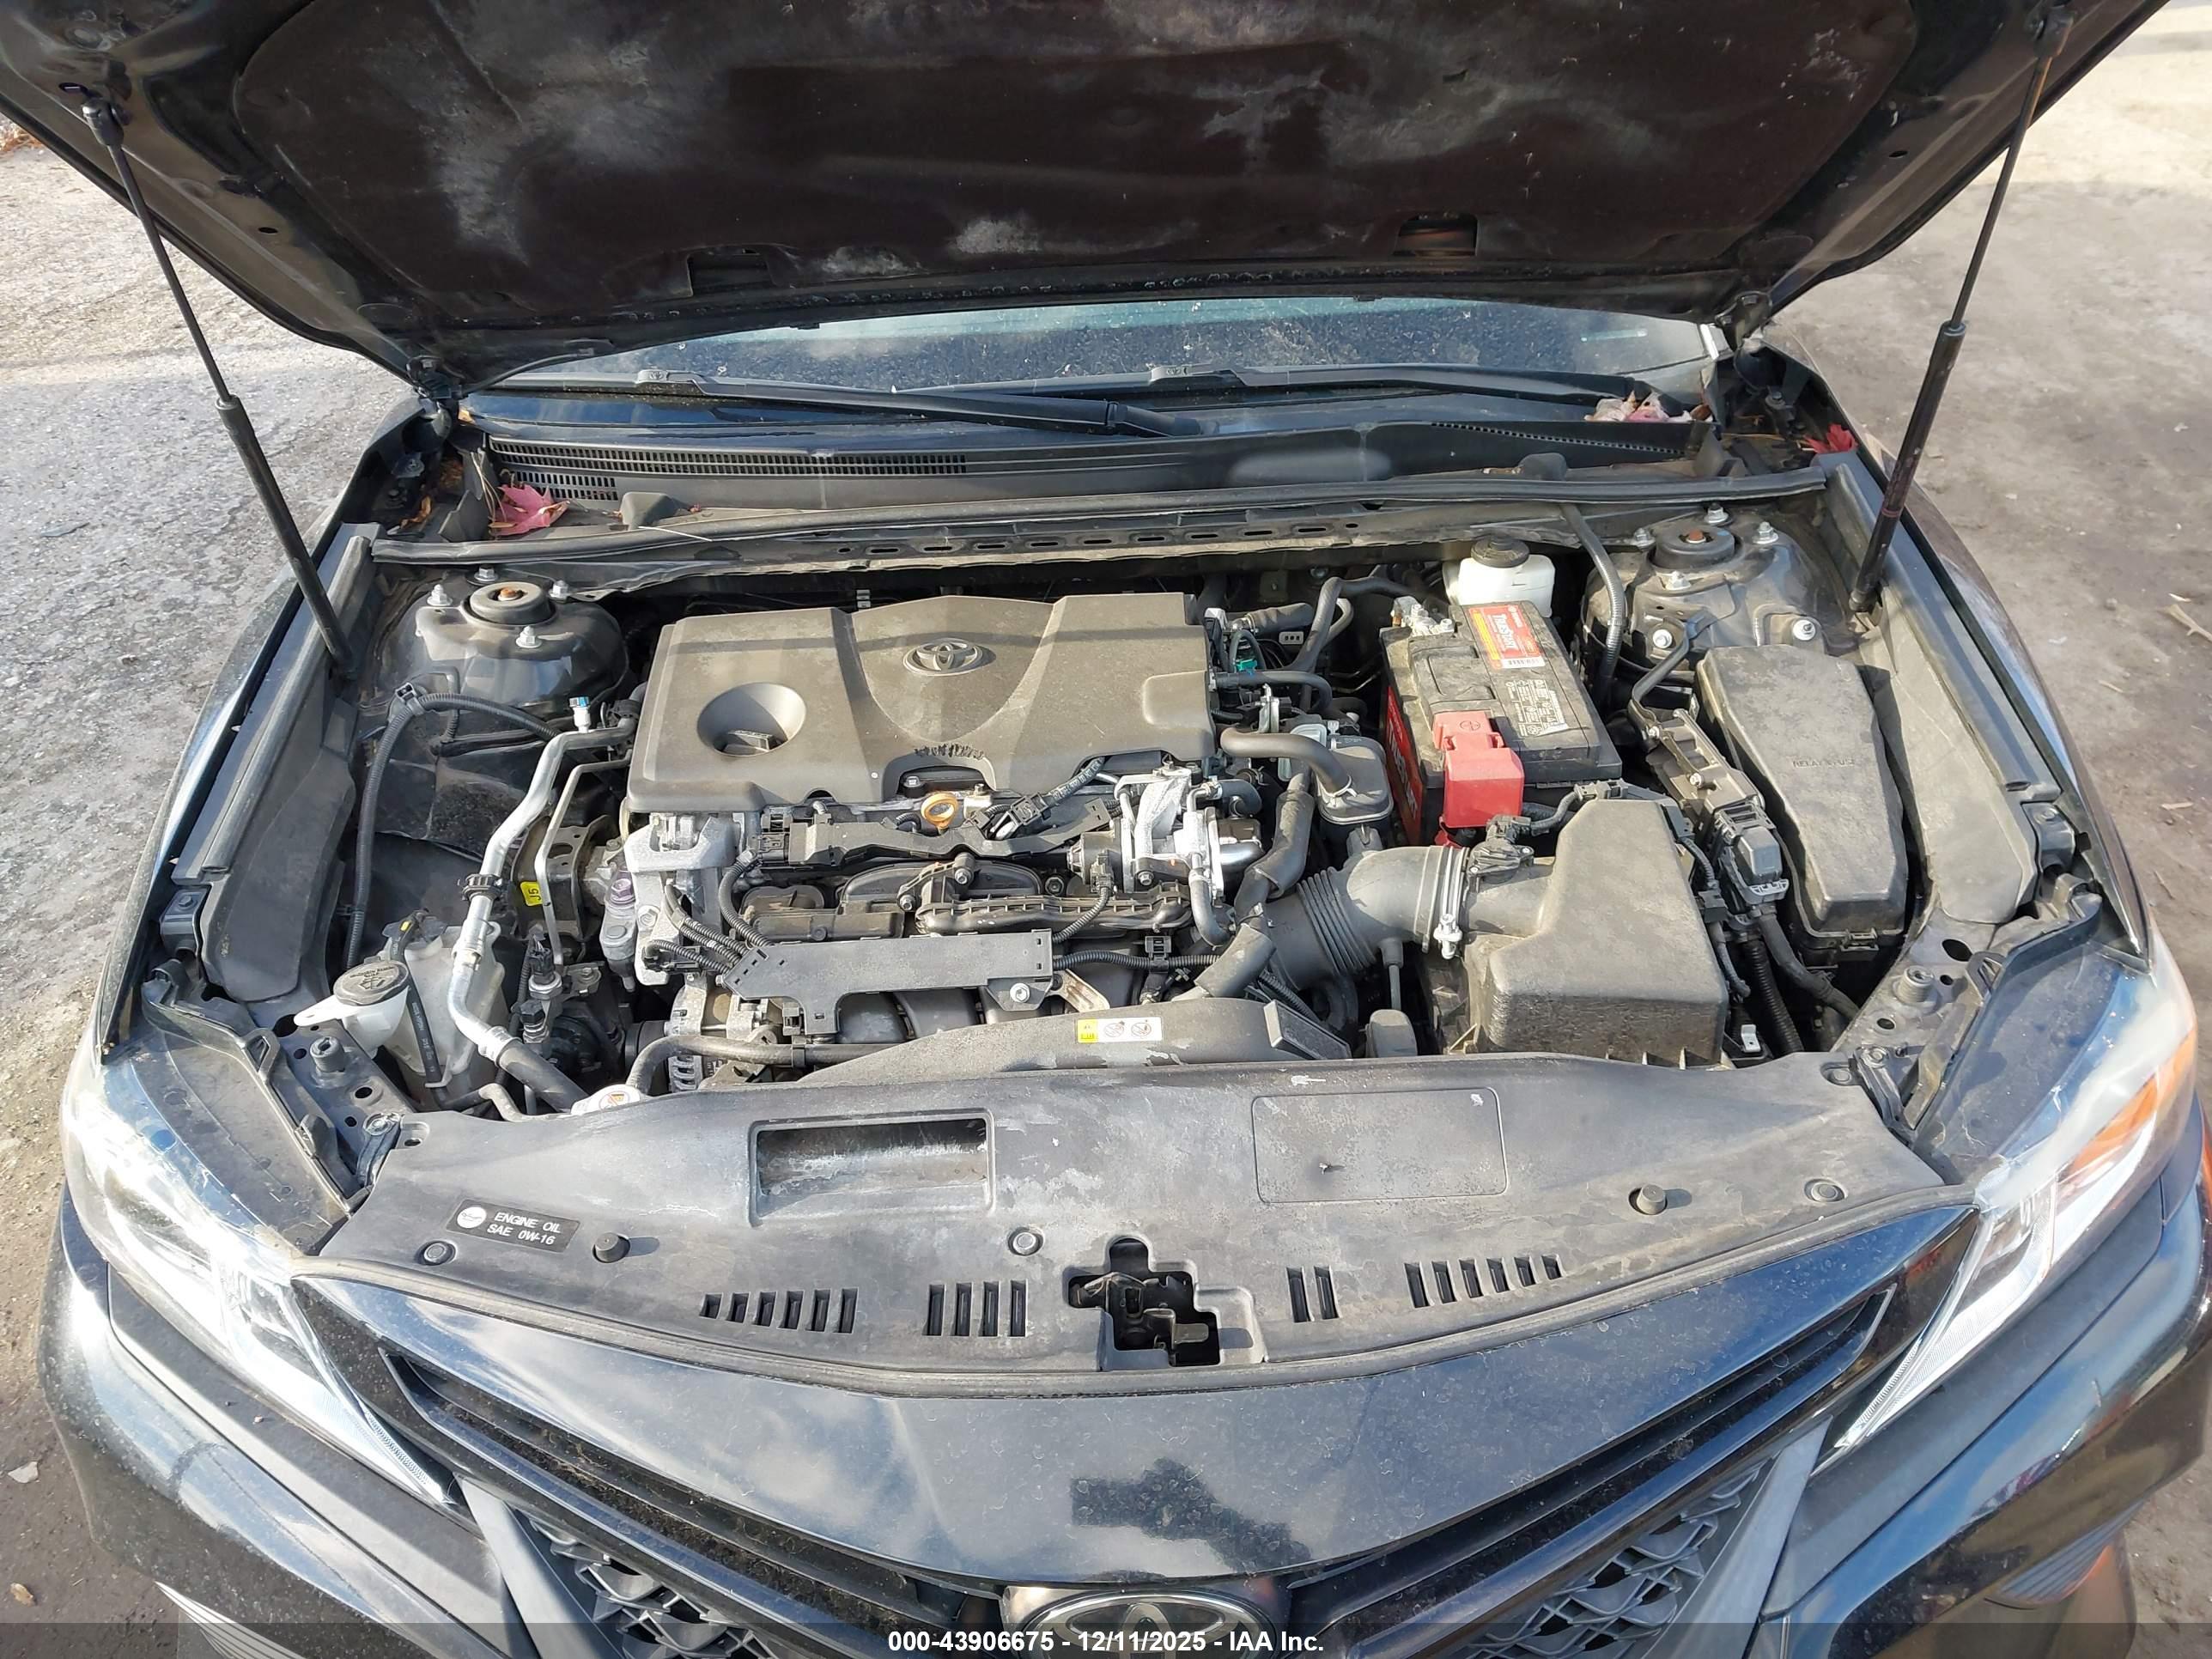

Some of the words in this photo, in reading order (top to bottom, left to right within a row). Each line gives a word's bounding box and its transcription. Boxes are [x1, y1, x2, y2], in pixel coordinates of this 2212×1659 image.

[494, 1212, 539, 1229] ENGINE
[542, 1221, 561, 1234] OIL
[487, 1224, 514, 1237] SAE
[518, 1230, 556, 1245] 0W-16
